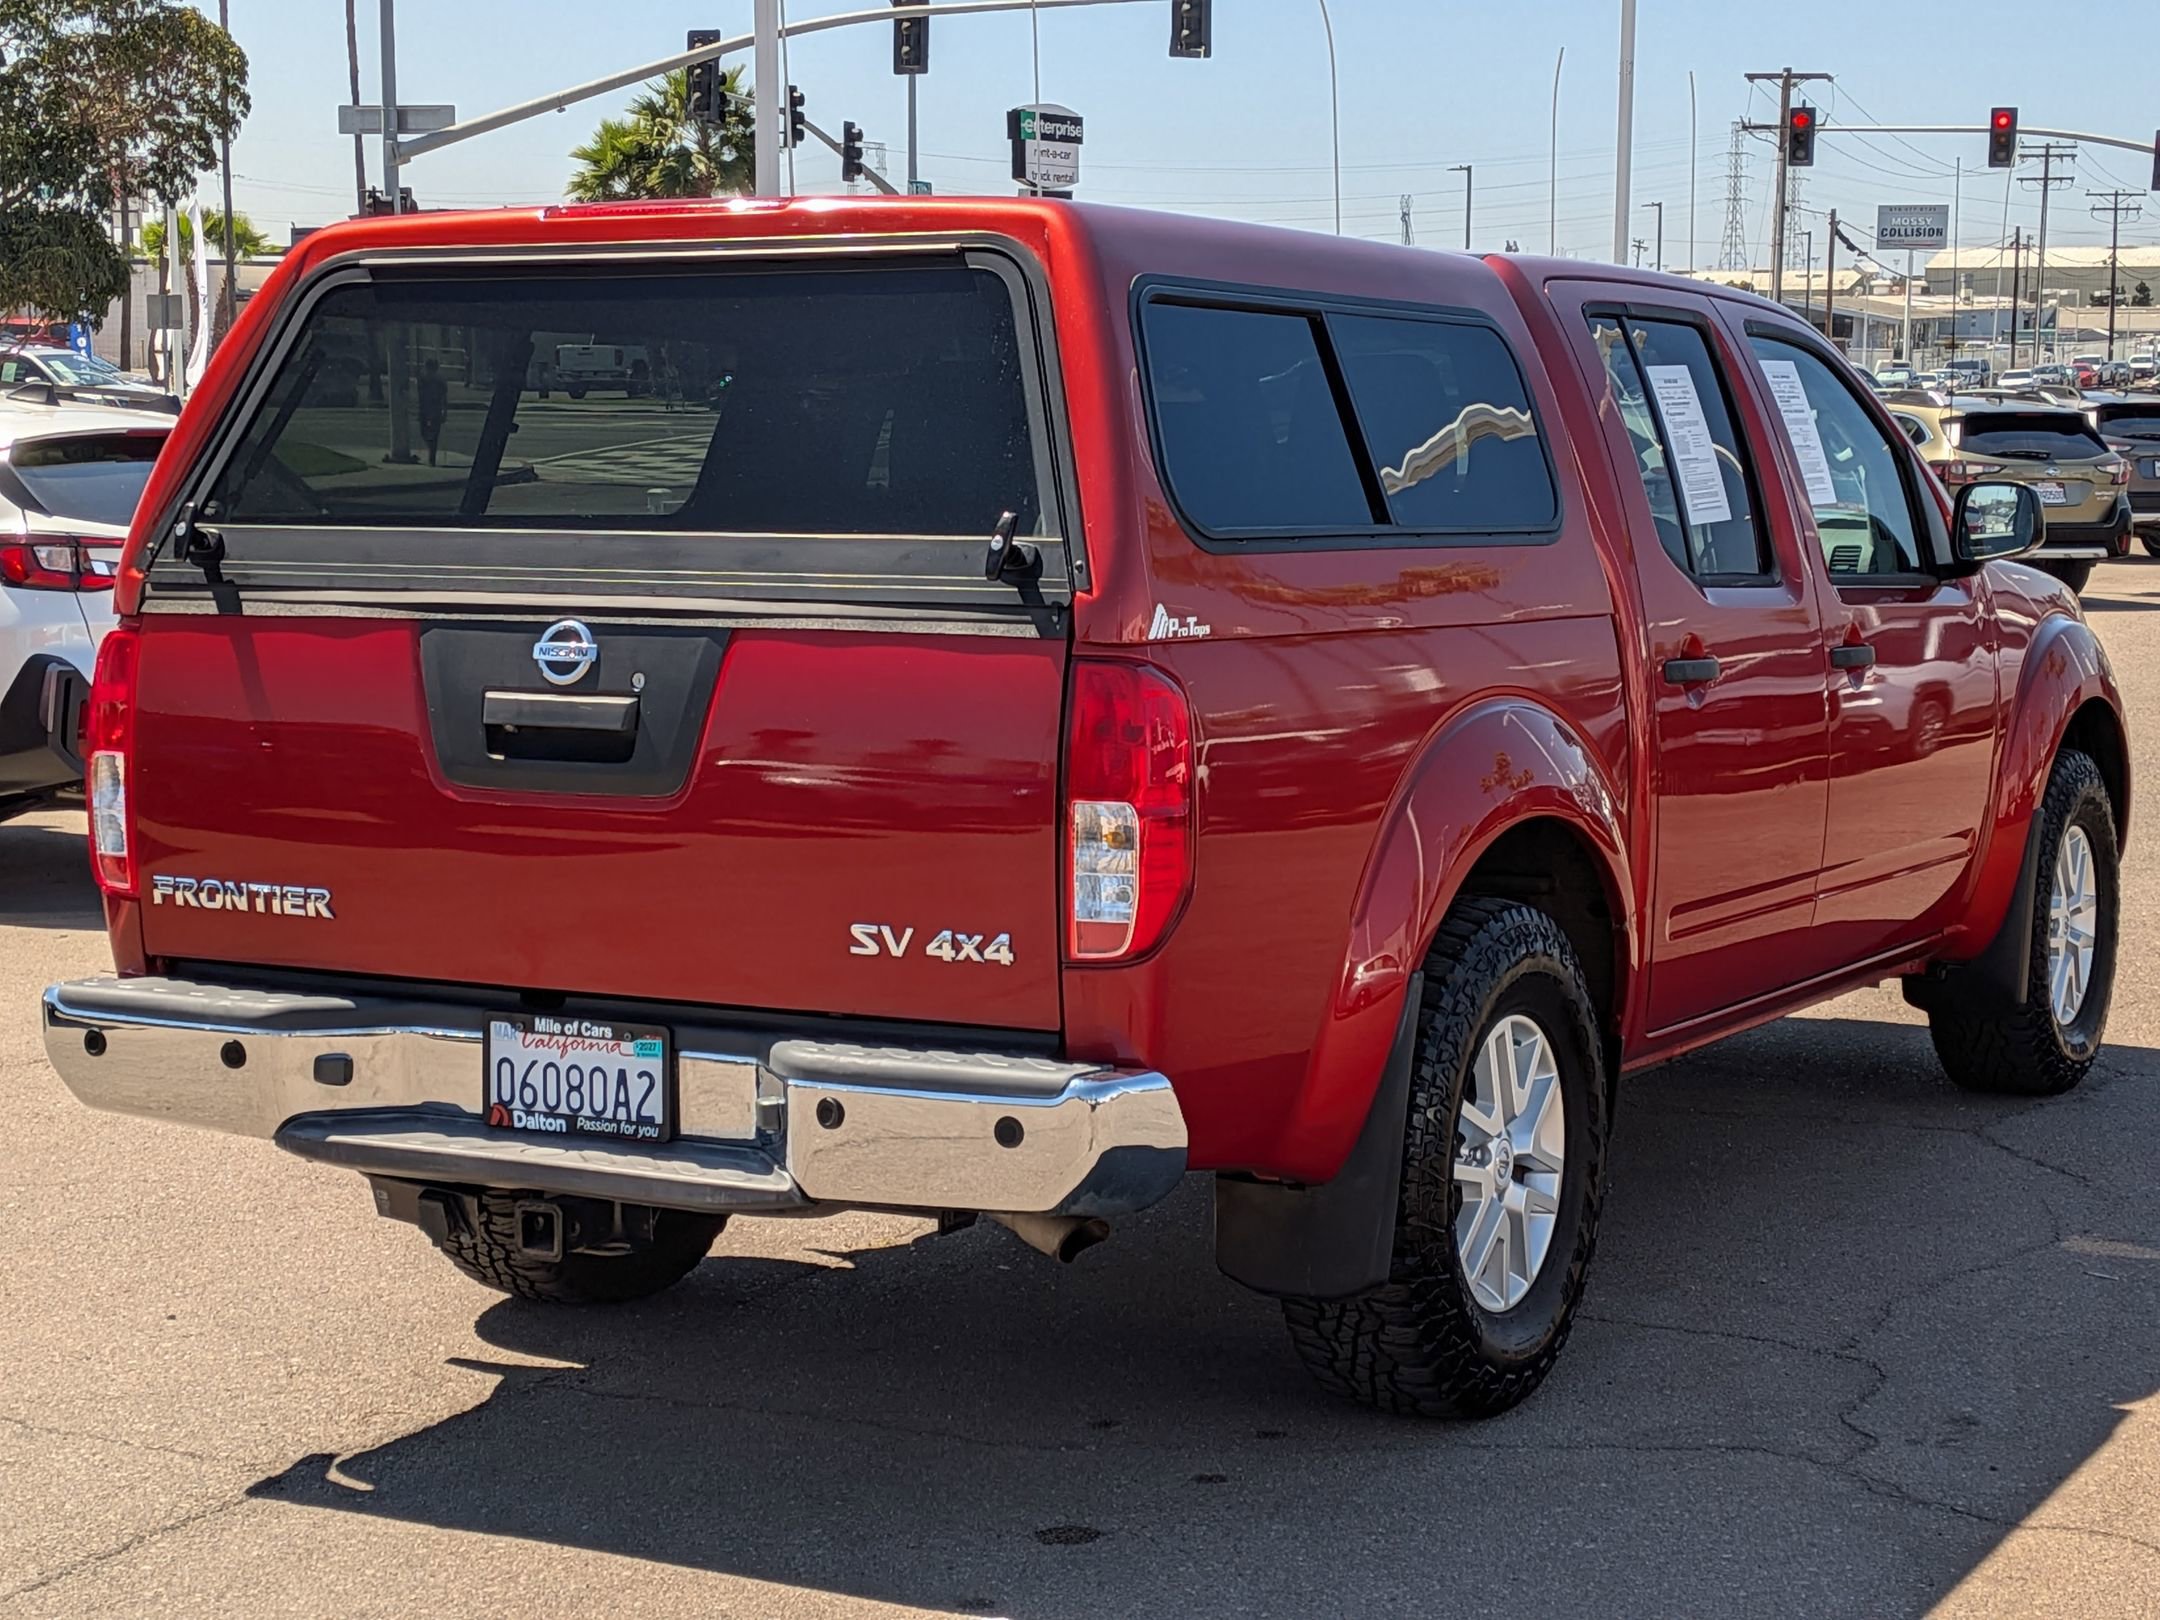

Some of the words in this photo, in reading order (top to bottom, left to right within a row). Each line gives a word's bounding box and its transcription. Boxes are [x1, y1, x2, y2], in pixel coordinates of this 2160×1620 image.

[1033, 148, 1071, 159] rnt-a-car
[1881, 228, 1943, 237] COLLISION
[1891, 217, 1932, 226] MOSSY
[1168, 616, 1210, 638] ProTops
[539, 647, 588, 657] NISSAN
[153, 875, 334, 919] FRONTIER
[850, 924, 914, 957] SV
[534, 1017, 561, 1034] Mile
[565, 1020, 579, 1036] of
[581, 1022, 613, 1038] Cars
[521, 1032, 634, 1059] California
[497, 1057, 656, 1124] 06080A2
[513, 1111, 566, 1132] Dalton
[577, 1117, 616, 1133] Passion
[619, 1120, 635, 1135] for
[637, 1126, 659, 1138] you
